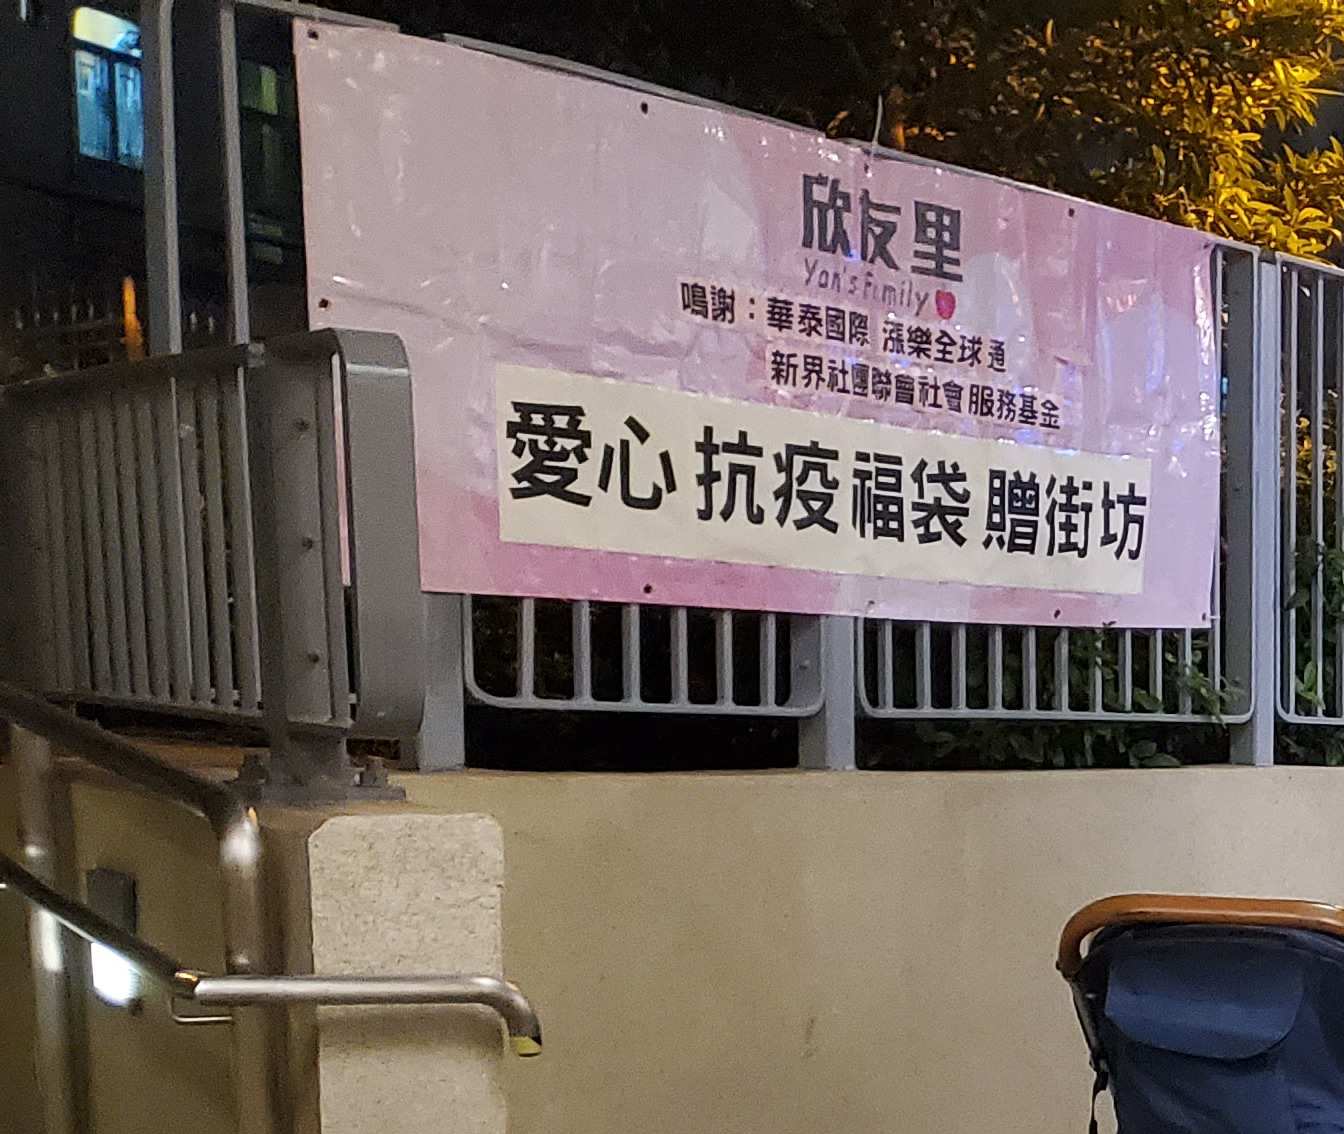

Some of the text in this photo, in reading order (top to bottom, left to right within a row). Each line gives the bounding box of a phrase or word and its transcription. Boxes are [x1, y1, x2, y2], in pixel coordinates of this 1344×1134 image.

[801, 172, 963, 283] 欣友里
[770, 349, 1062, 430] 新界社團聯會社會服務基金
[882, 318, 1008, 374] 漲樂全球通
[506, 401, 1148, 562] 愛心抗疫福袋贈街坊
